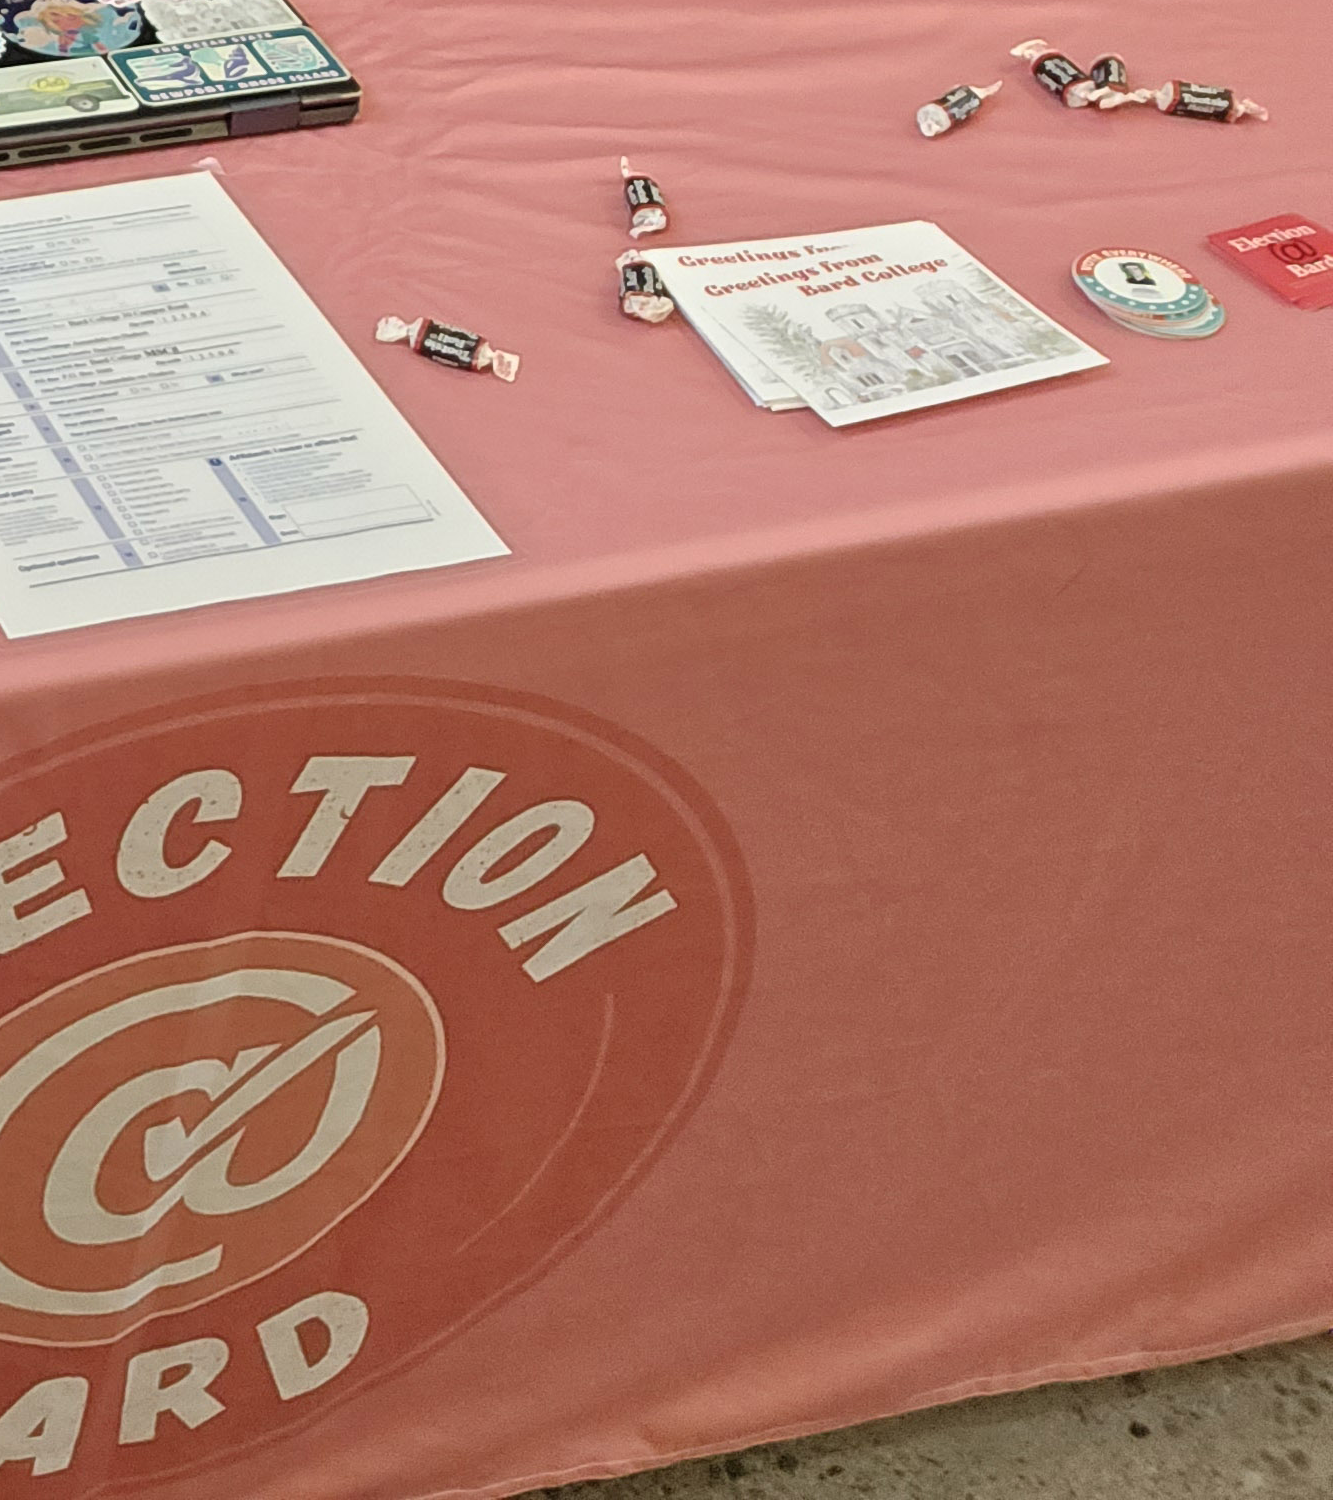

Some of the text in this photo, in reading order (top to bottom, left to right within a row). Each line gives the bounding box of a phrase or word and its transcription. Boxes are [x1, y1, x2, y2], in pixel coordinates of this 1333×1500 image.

[182, 39, 228, 50] OCEAN
[149, 84, 226, 101] NEWPORT
[289, 70, 340, 82] ISLAND
[1227, 225, 1317, 252] Election
[677, 248, 802, 267] Greetings
[1080, 249, 1193, 280] VOTE EVERYWHERE
[704, 253, 884, 298] Greetings from
[797, 257, 948, 297] Bard College
[422, 337, 470, 360] Tootsie
